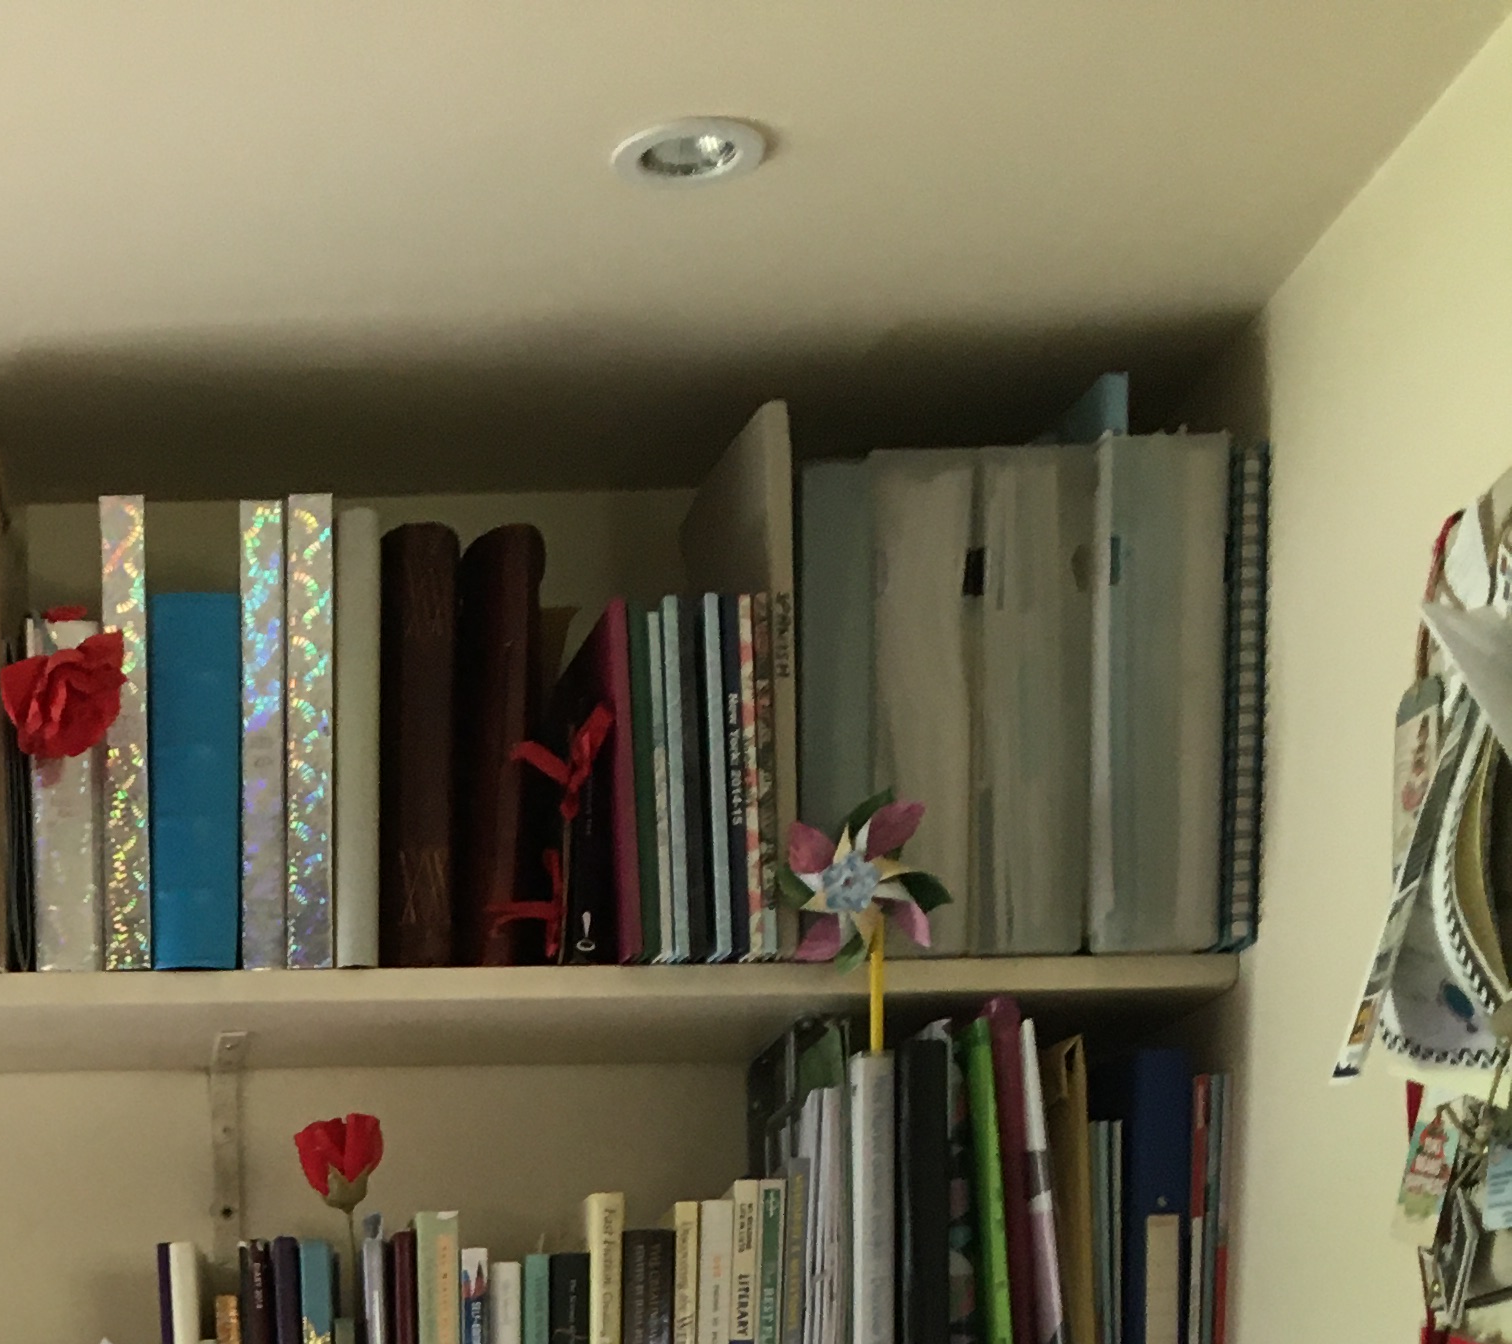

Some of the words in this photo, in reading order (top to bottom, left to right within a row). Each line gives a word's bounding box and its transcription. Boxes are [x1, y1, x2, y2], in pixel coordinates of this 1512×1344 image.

[774, 592, 792, 679] SPANISH
[727, 692, 740, 726] New
[730, 769, 743, 826] 2014-15
[603, 1208, 615, 1236] Fast
[253, 1262, 262, 1287] DIARY
[569, 1279, 577, 1293] The
[737, 1274, 750, 1336] LITERARY
[763, 1287, 775, 1322] BEST
